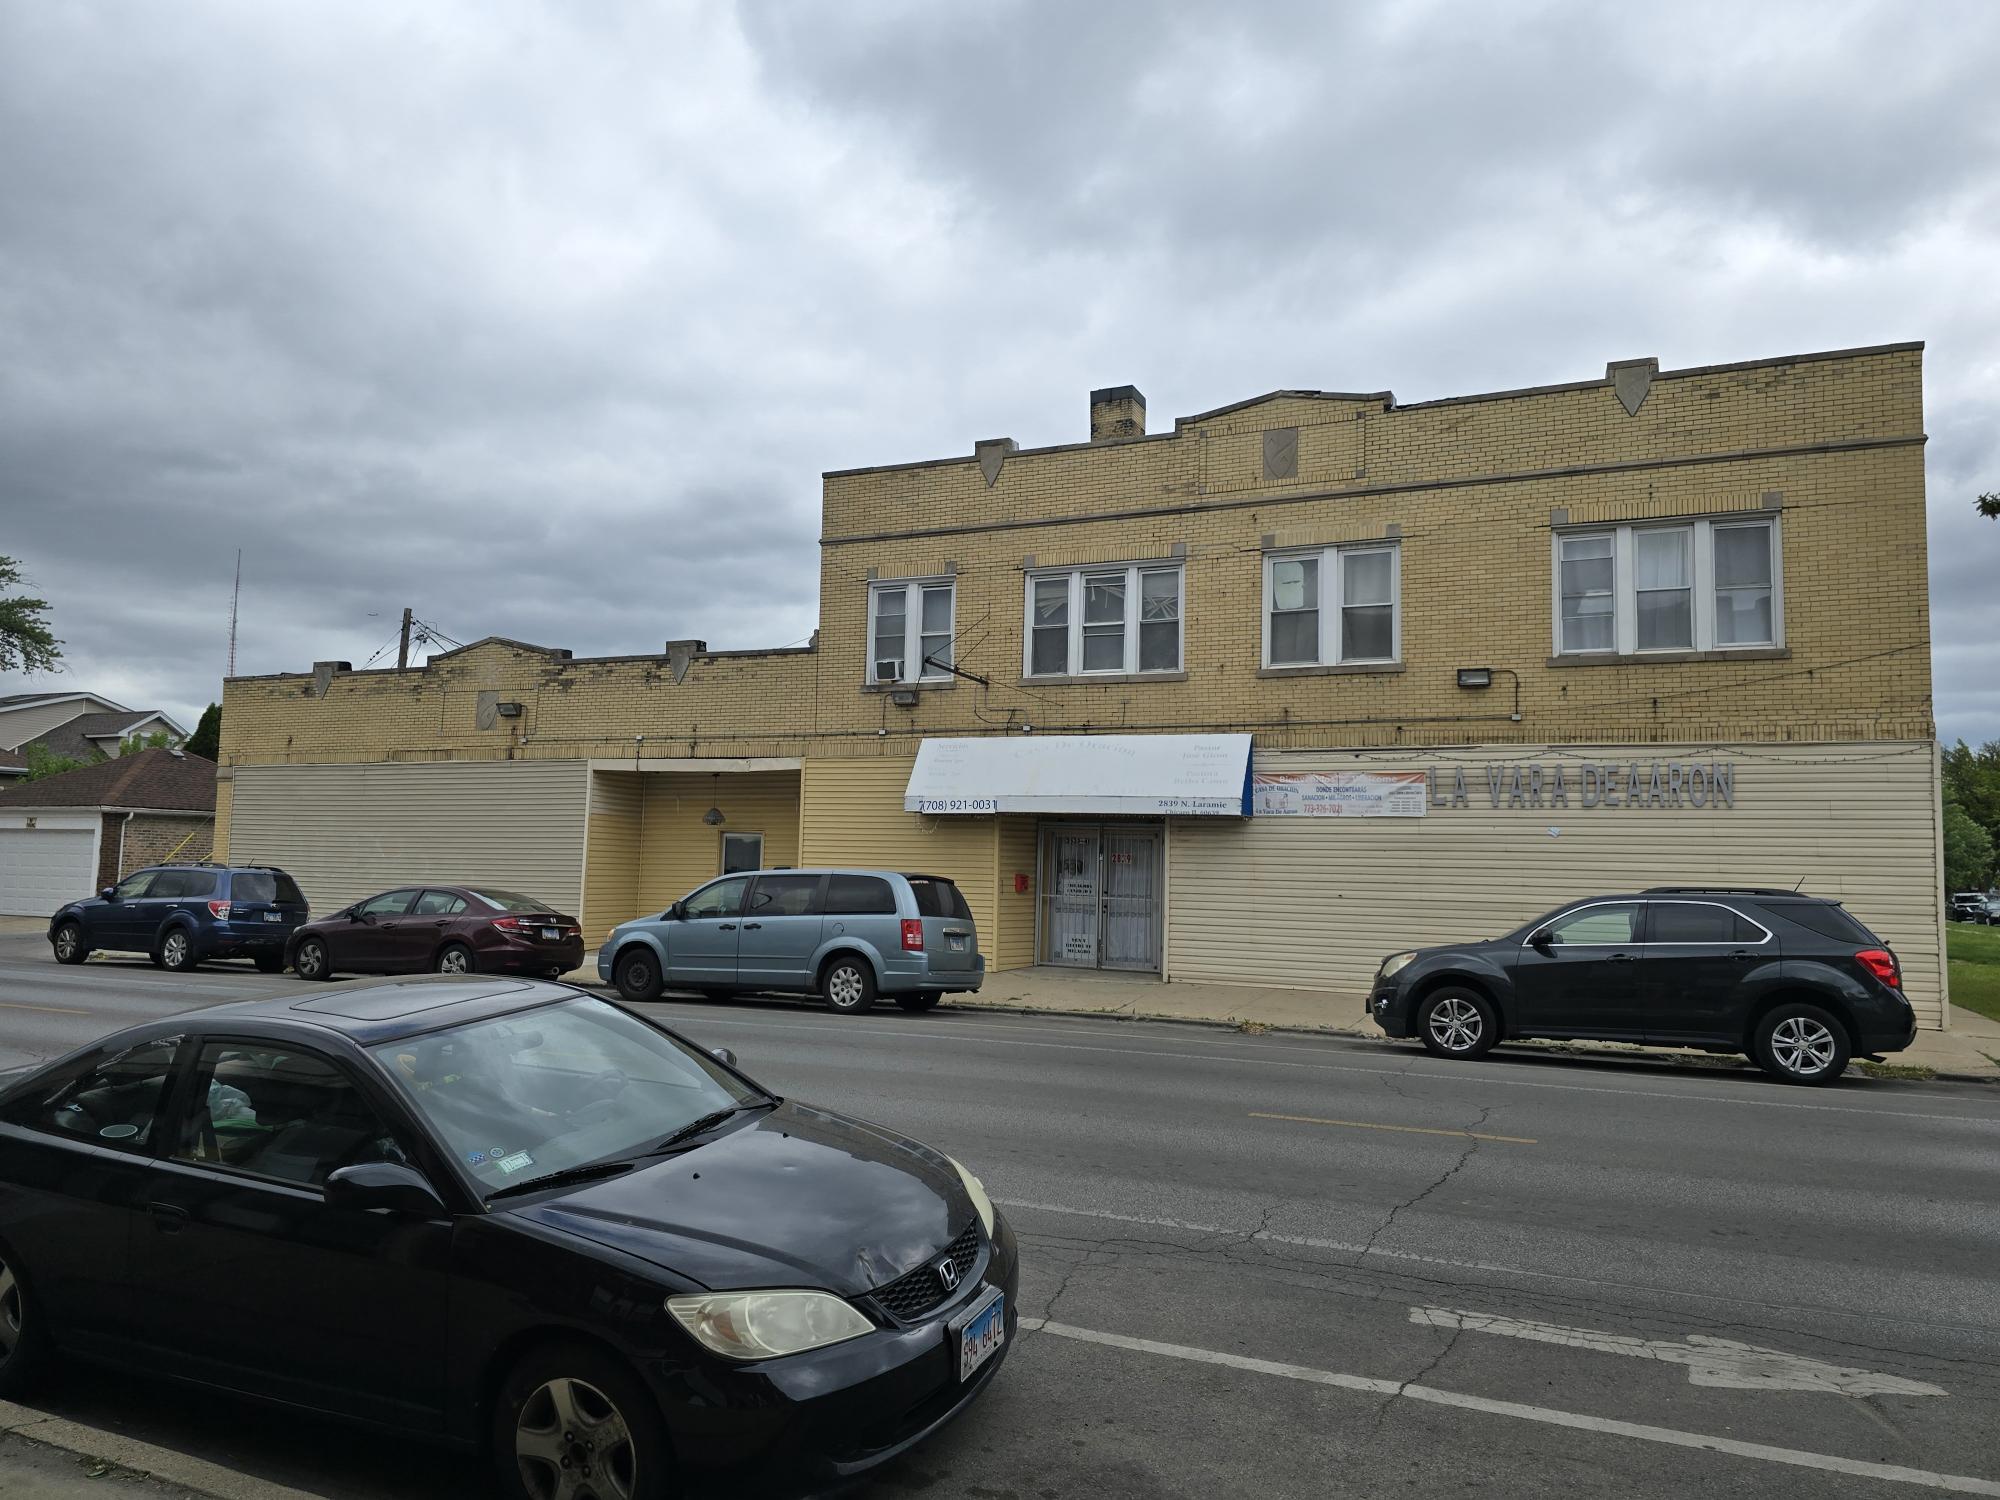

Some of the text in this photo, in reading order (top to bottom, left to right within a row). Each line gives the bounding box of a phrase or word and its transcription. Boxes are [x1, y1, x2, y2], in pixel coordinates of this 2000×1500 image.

[1430, 765, 1469, 808] LA
[1486, 763, 1568, 808] VARA
[950, 799, 996, 810] 921-0031
[1193, 801, 1227, 809] Laramie
